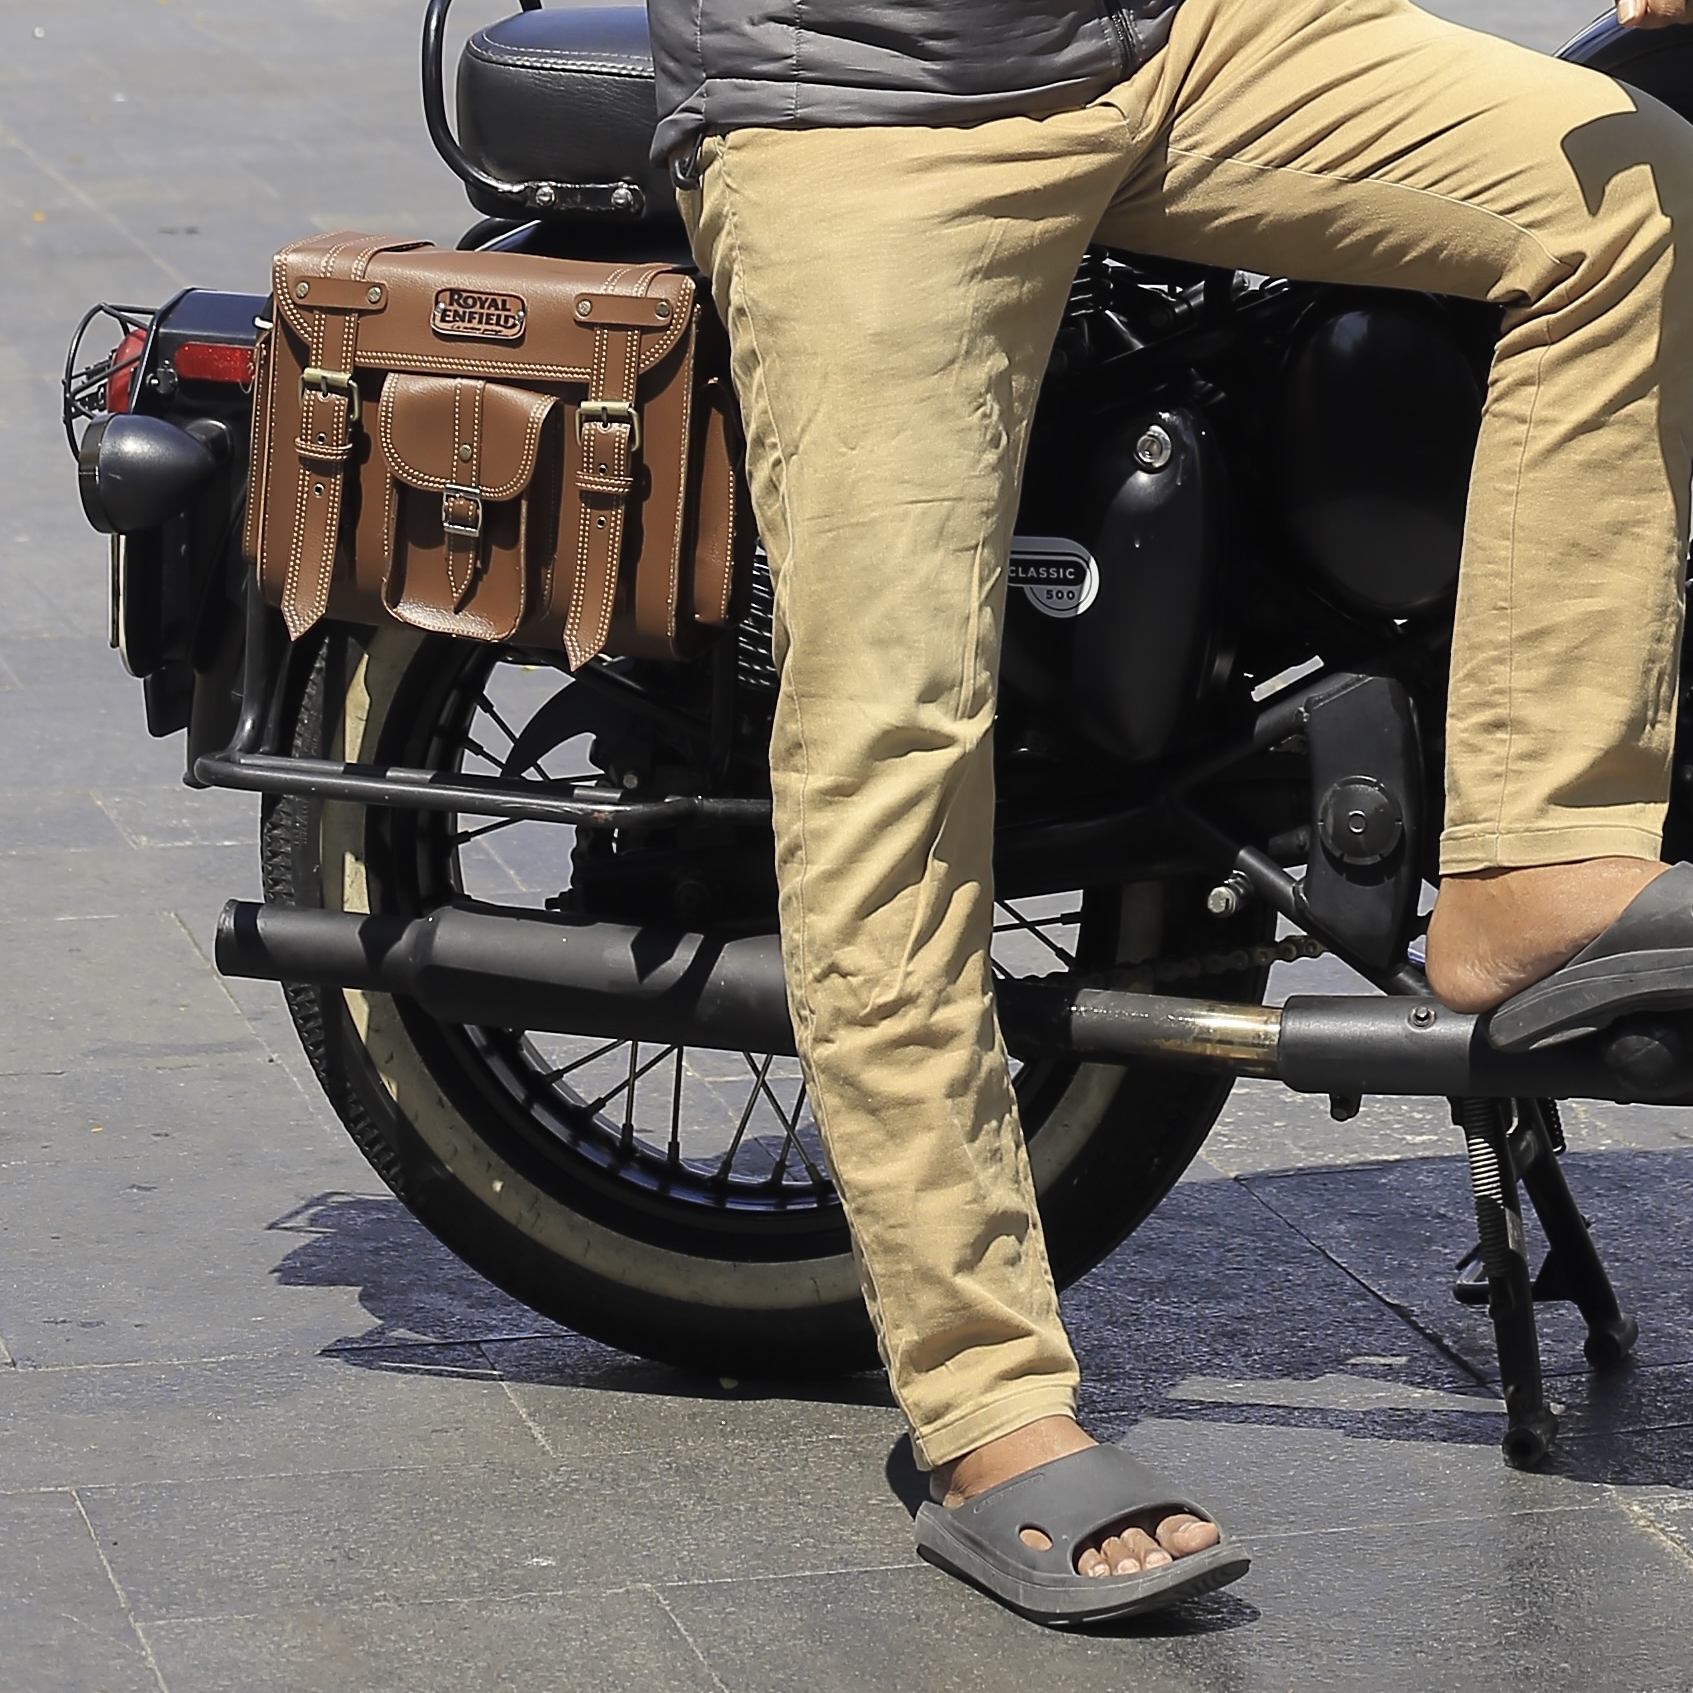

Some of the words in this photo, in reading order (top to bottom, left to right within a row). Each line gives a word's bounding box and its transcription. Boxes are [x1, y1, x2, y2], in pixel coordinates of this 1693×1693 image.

[448, 290, 511, 312] ROYAL
[440, 308, 520, 329] ENFIELD
[1008, 566, 1075, 579] CLASSIC
[1045, 590, 1076, 601] 500
